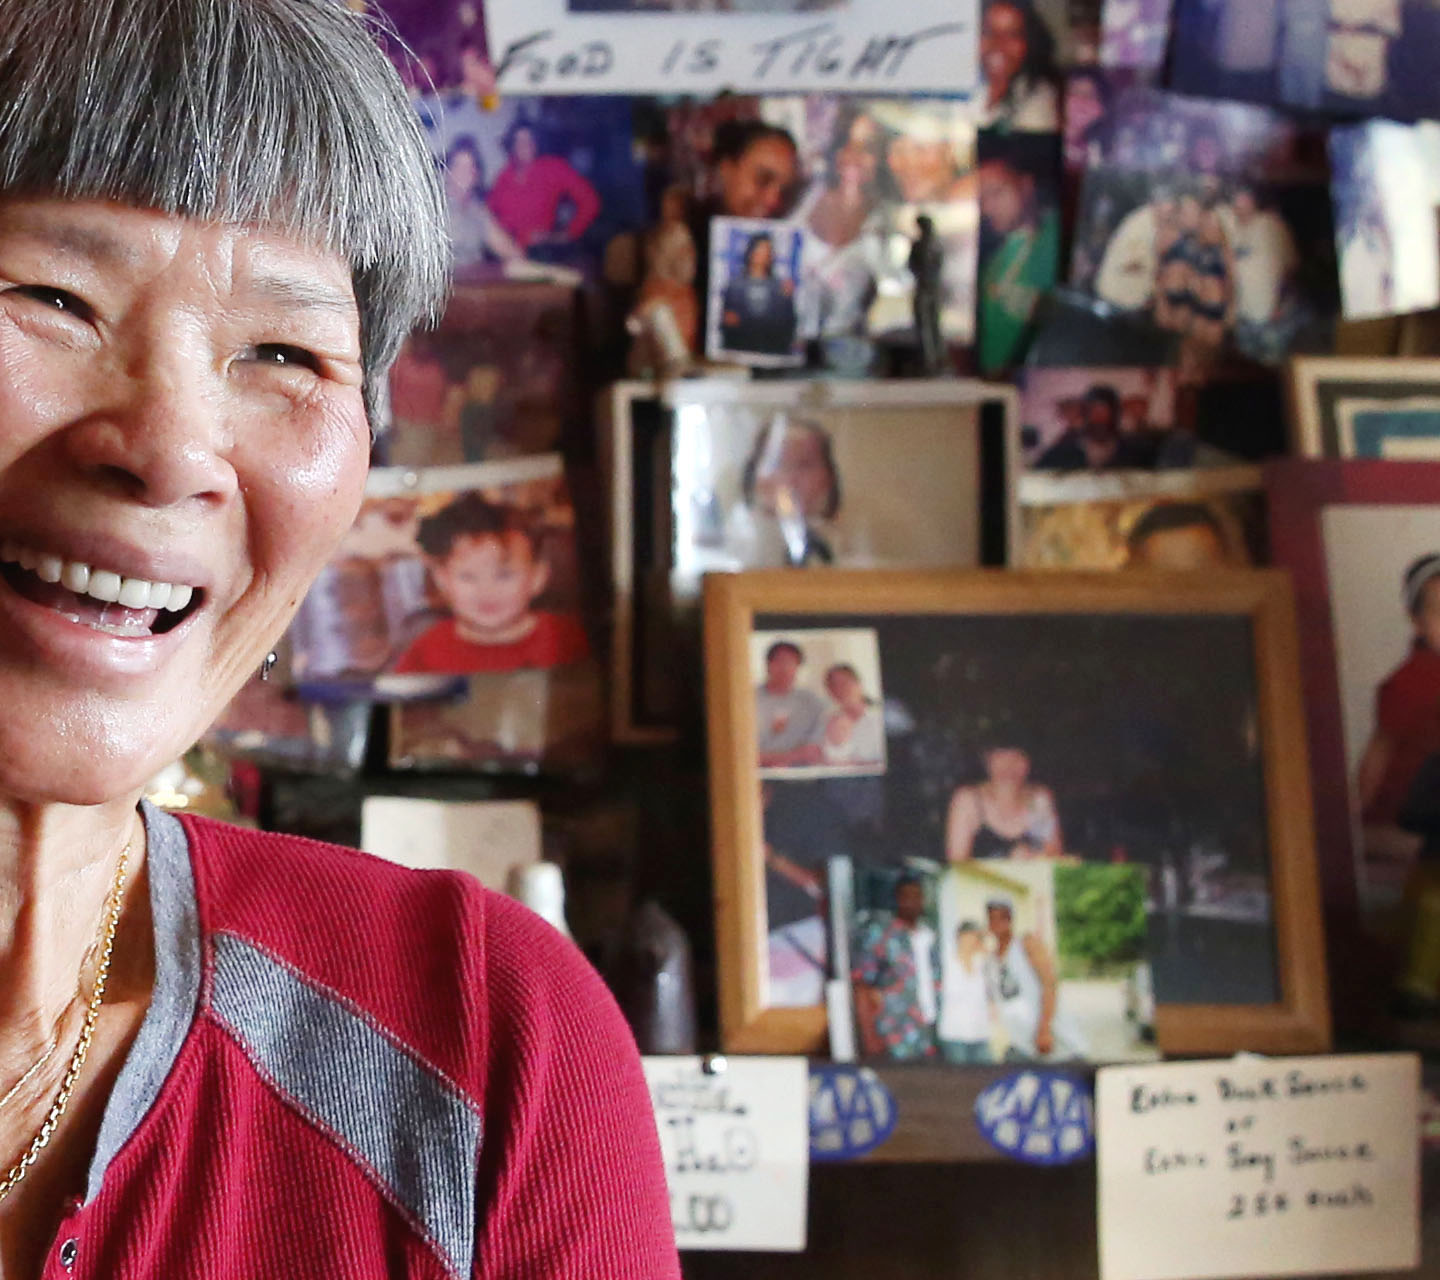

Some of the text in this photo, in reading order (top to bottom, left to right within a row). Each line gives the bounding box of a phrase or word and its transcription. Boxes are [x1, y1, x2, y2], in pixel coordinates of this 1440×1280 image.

[494, 21, 966, 84] FOOD IS TIGHT
